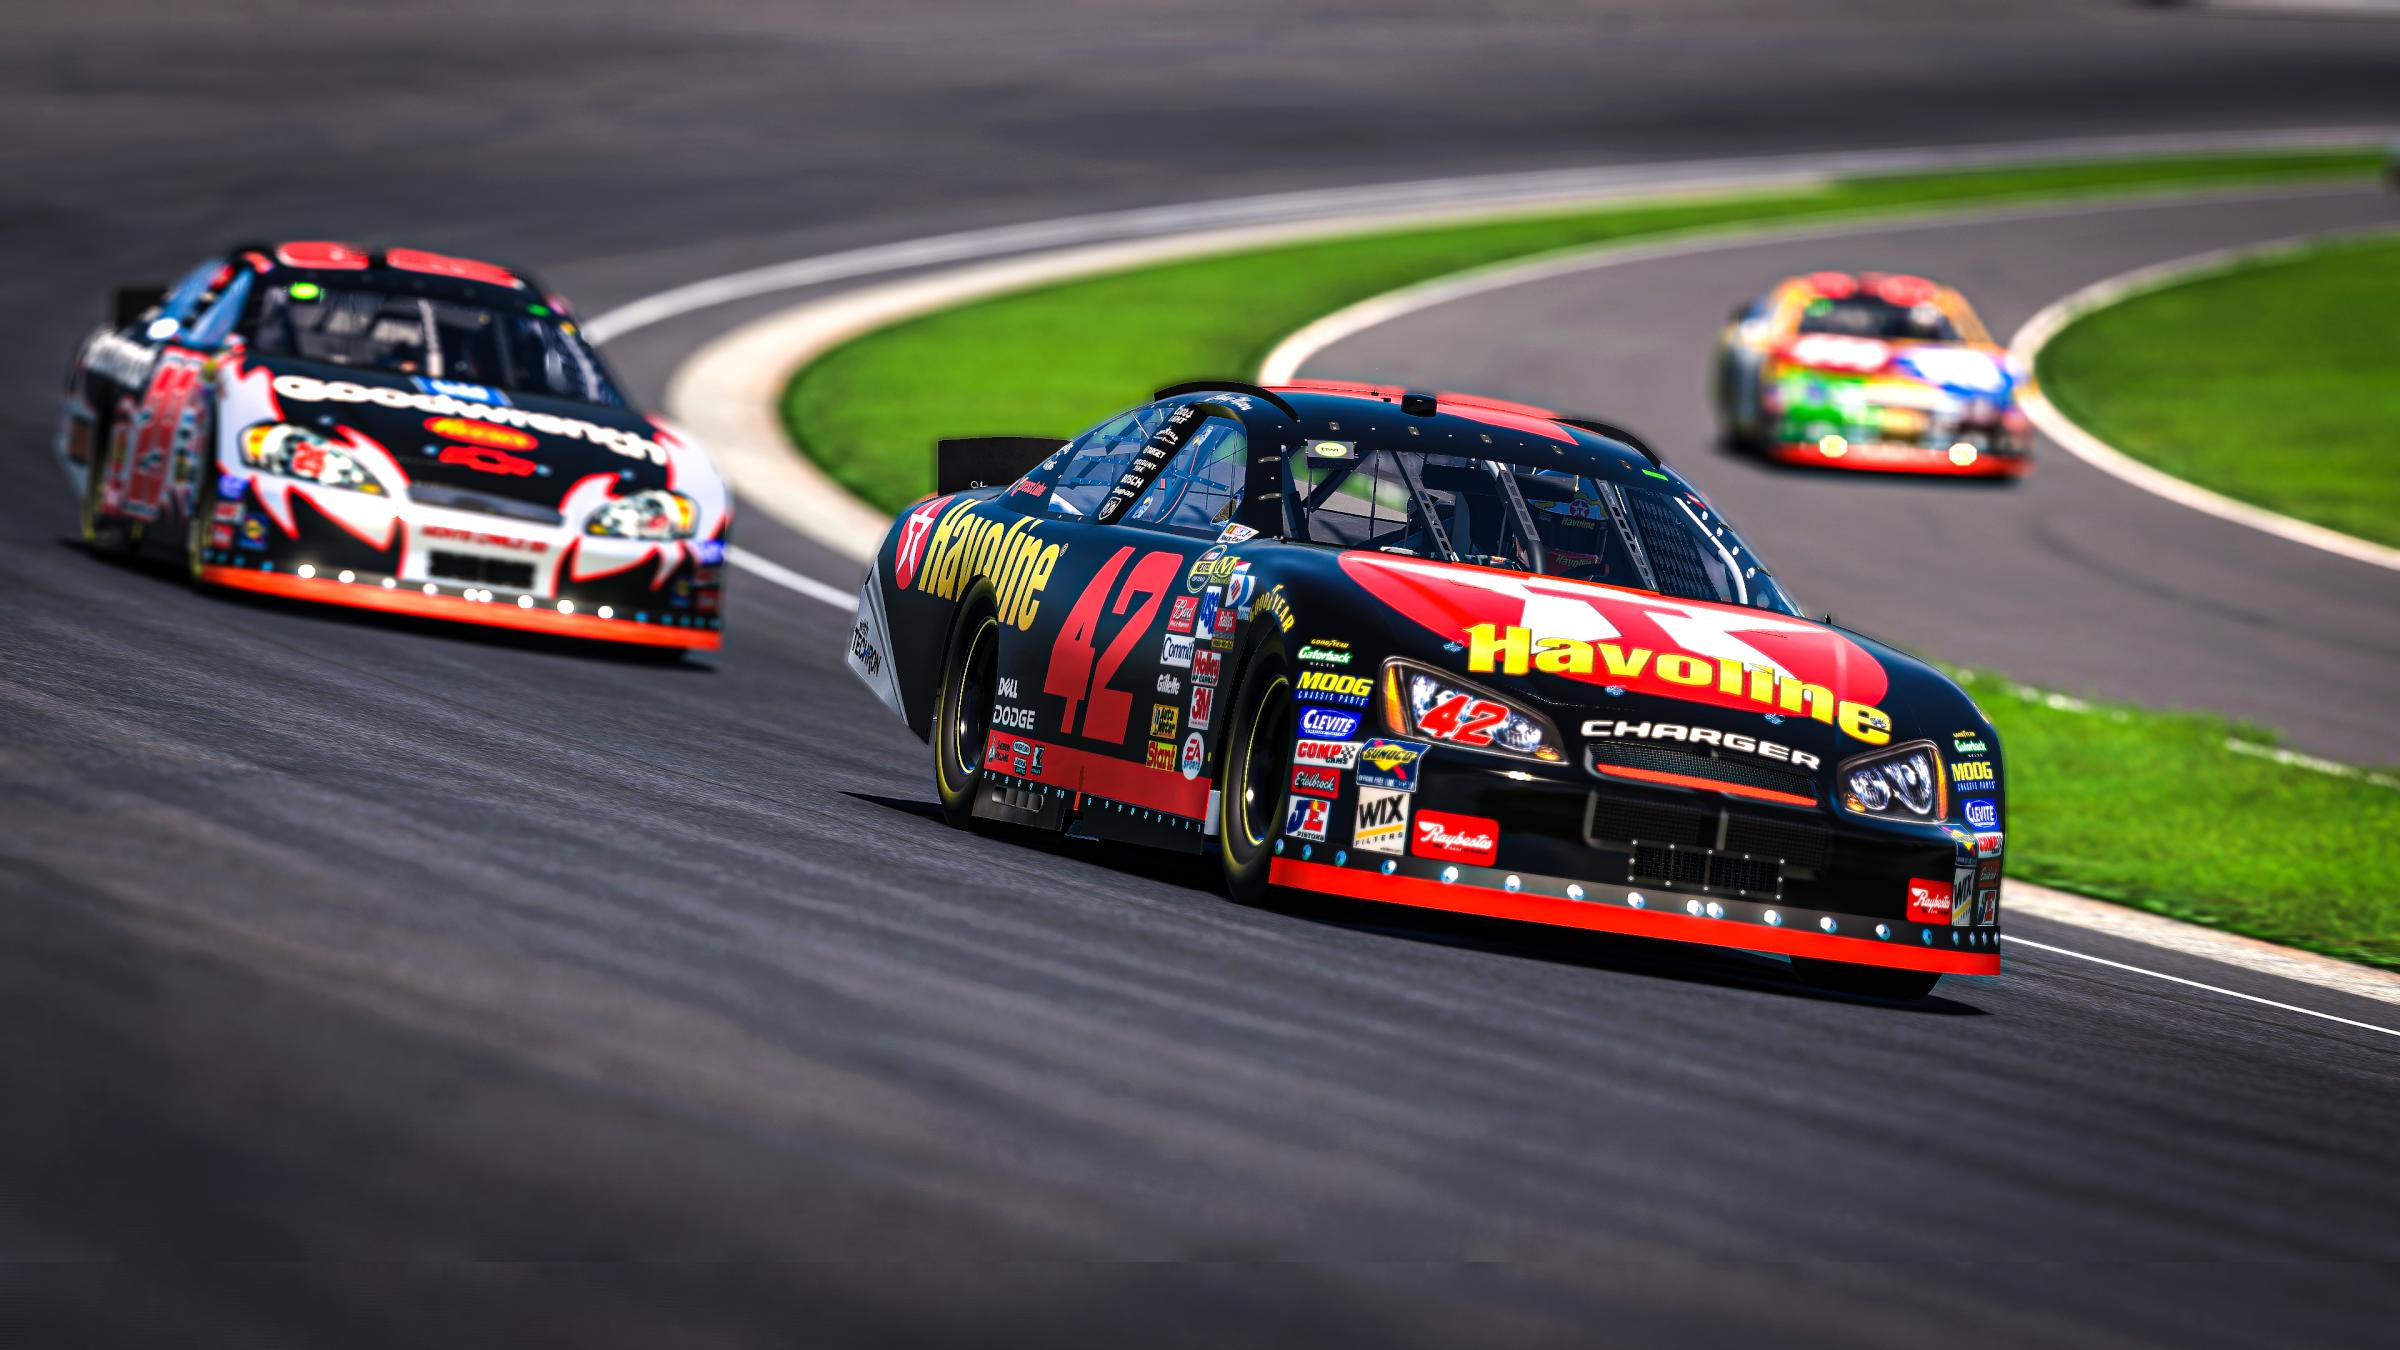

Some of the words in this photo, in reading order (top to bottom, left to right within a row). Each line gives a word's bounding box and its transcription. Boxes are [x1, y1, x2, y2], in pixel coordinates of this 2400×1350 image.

[918, 499, 1061, 631] Havoline
[1173, 600, 1197, 619] Bud
[1249, 583, 1296, 633] GOODYEAR
[852, 627, 882, 677] TECHRON
[1043, 545, 1184, 745] 42
[1162, 637, 1194, 661] Commit
[1298, 645, 1351, 664] Gatorback
[1311, 639, 1350, 648] GOODYEAR
[997, 677, 1018, 699] DELL
[1157, 674, 1181, 695] Gillette
[1297, 671, 1375, 697] MOOG
[1466, 623, 1892, 746] Havoline
[1191, 687, 1213, 721] 3M
[1297, 690, 1334, 702] CHASSIS
[1338, 694, 1367, 706] PARTS
[992, 704, 1036, 730] DODGE
[1303, 709, 1356, 733] CLEVITE
[1416, 692, 1511, 747] 42
[1184, 738, 1200, 761] EA
[1297, 742, 1343, 759] COMP
[1363, 747, 1414, 762] SUNOCO
[1580, 719, 1822, 771] CHARGER
[1326, 756, 1349, 765] CAMS
[1951, 761, 1993, 781] MOOG
[1294, 771, 1334, 791] Edelbrock
[1359, 794, 1405, 829] WIX
[1965, 802, 1995, 823] CLEVITE
[1355, 832, 1405, 847] FILTERS
[1418, 821, 1493, 850] Raybestos
